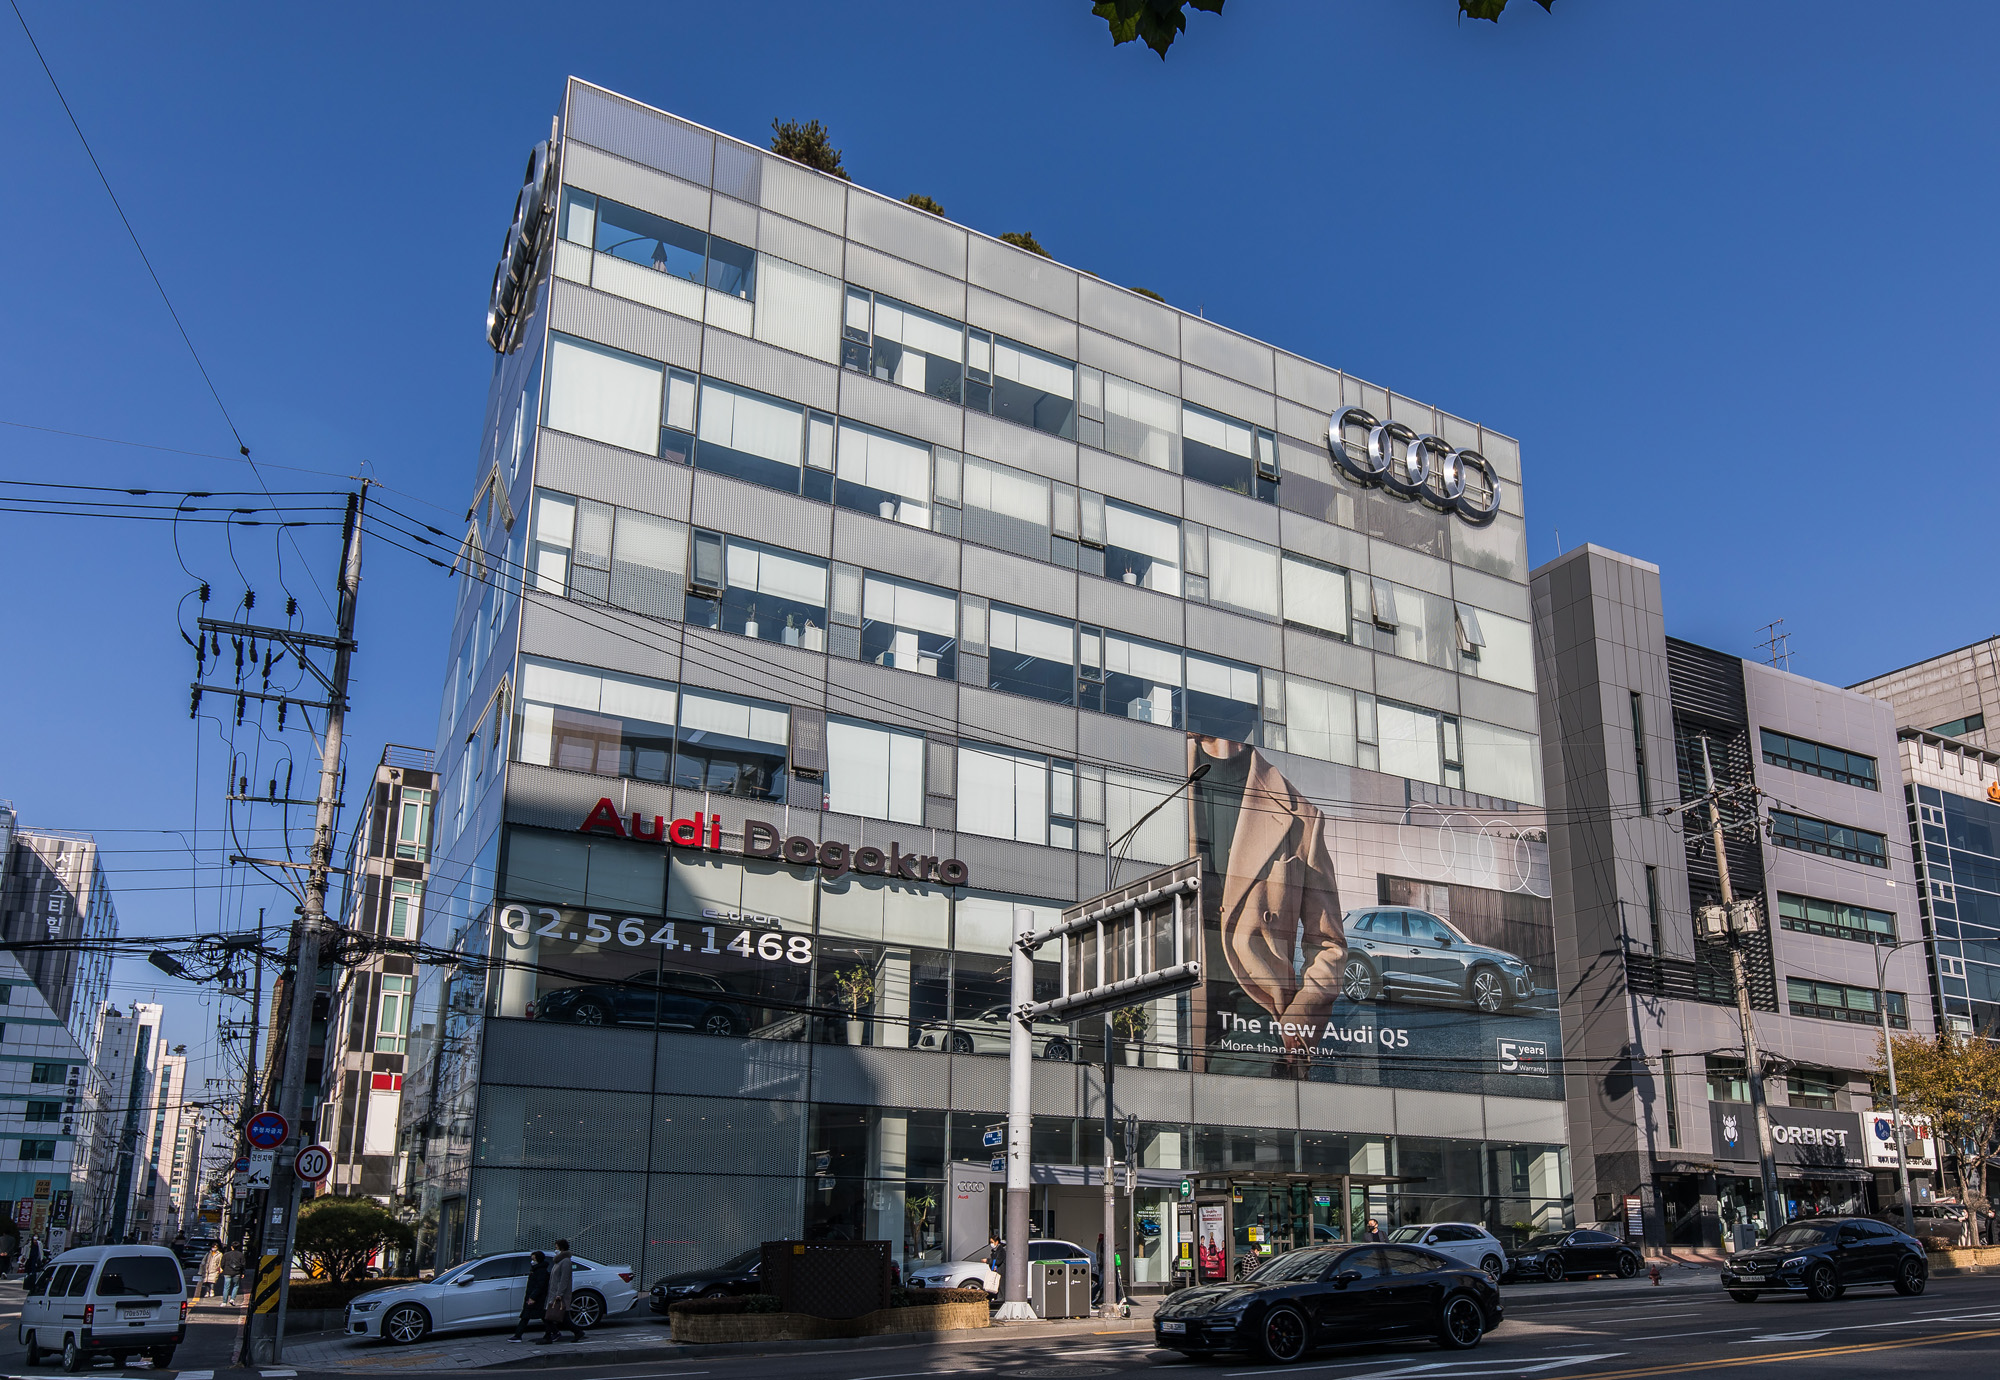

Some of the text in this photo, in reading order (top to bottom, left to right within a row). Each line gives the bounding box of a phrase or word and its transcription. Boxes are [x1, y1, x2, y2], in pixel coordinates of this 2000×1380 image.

[579, 797, 968, 886] Audi Dogokro
[46, 850, 72, 942] 서희스타힐
[701, 907, 782, 926] e-tron
[500, 904, 813, 964] 02.564.1468
[1216, 1010, 1409, 1050] The new Audi Q5
[1220, 1038, 1254, 1051] More
[1257, 1042, 1287, 1055] than
[1501, 1043, 1518, 1071] 5
[1518, 1045, 1545, 1056] years
[1519, 1064, 1546, 1074] Warranty
[252, 1126, 283, 1135] 주정차금지
[1769, 1124, 1849, 1147] ORBIST
[251, 1153, 273, 1162] 견인지역
[302, 1153, 324, 1174] 30
